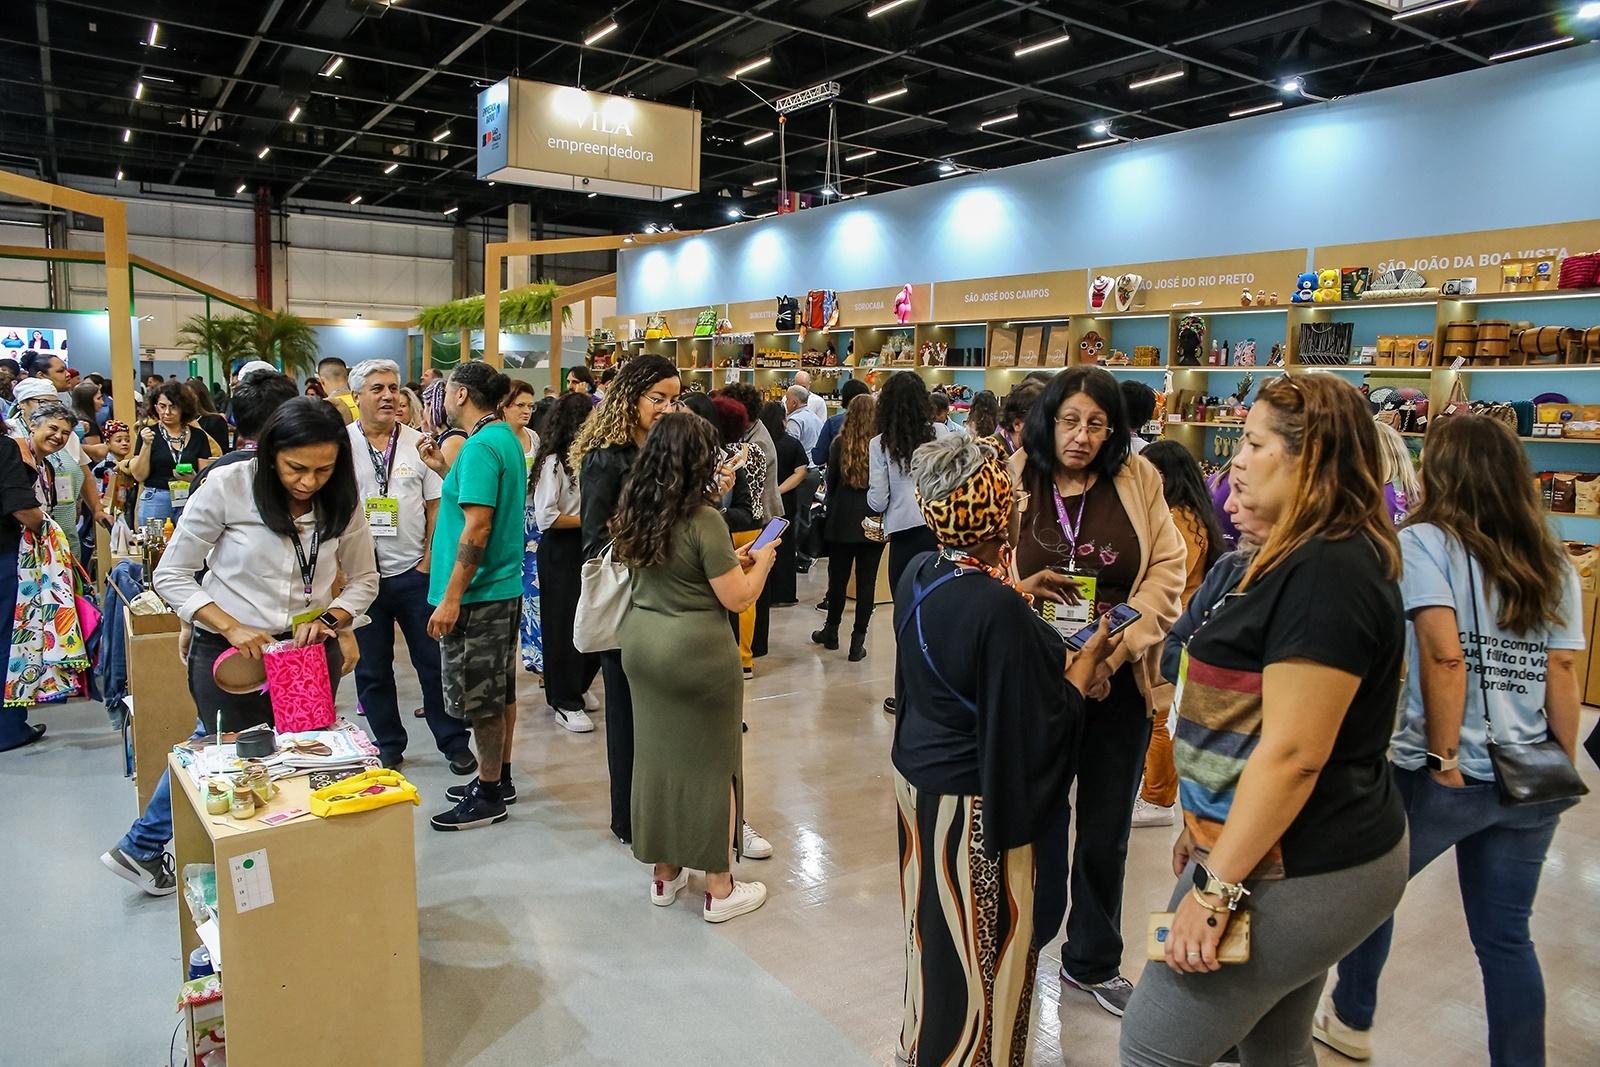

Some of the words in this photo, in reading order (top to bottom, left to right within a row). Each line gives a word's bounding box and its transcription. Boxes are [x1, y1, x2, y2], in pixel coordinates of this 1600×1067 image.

[547, 135, 654, 162] empreendedora
[1377, 258, 1406, 275] SÃO
[1412, 256, 1450, 271] JOÃO
[1453, 256, 1475, 268] DA
[1479, 251, 1512, 267] BOA
[1154, 276, 1180, 289] JOSÉ
[1181, 277, 1196, 288] DO
[1198, 275, 1216, 286] RIO
[1218, 272, 1255, 285] PRETO
[964, 292, 979, 303] SÃO
[979, 290, 999, 302] JOSÉ
[999, 291, 1015, 301] DOS
[1015, 288, 1050, 300] CAMPOS
